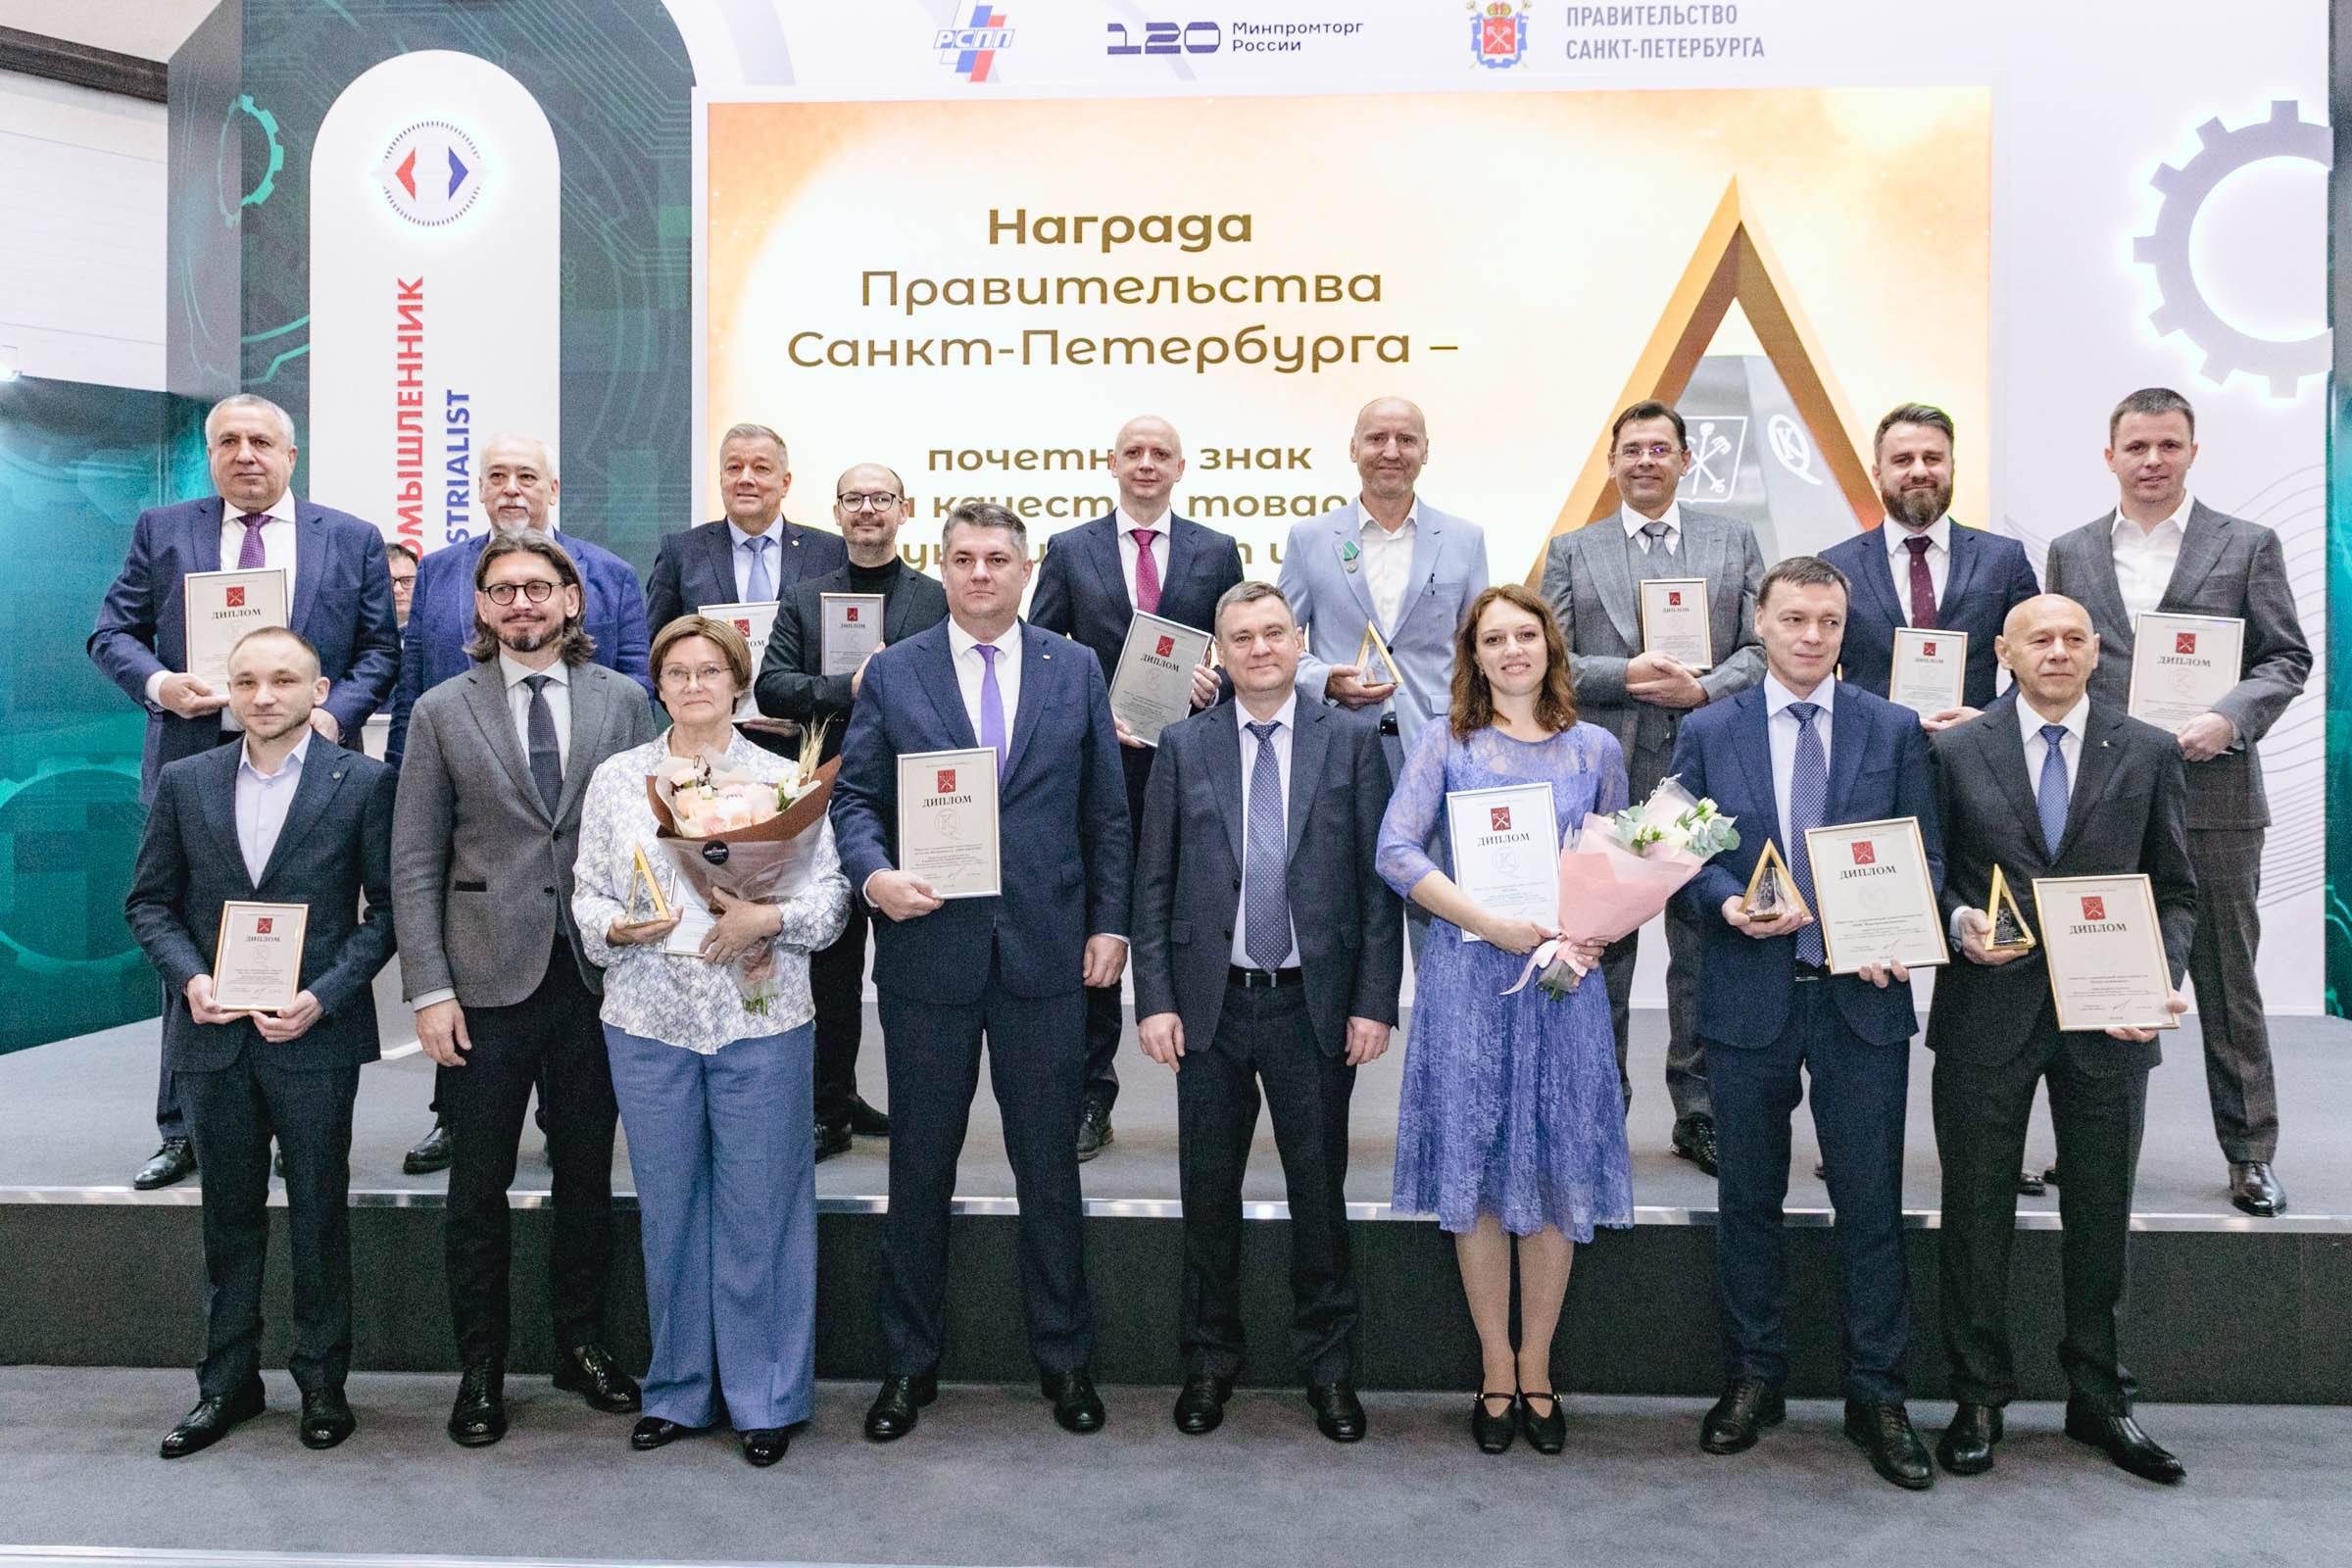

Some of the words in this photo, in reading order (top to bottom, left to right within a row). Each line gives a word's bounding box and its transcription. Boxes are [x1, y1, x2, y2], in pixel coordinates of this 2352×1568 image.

[1566, 4, 1738, 27] ПРАВИТЕЛЬСТВО
[933, 28, 1016, 49] РСПП
[1106, 22, 1221, 55] 120
[1232, 22, 1364, 37] Минпромторг
[1232, 39, 1301, 52] России
[1566, 36, 1766, 60] САНКТ-ПЕТЕРБУРГА
[989, 208, 1252, 253] Награда
[861, 270, 1383, 316] Правительства
[788, 323, 1411, 374] Санкт-Петербурга
[397, 276, 423, 562] МЫШЛЕННИК
[446, 389, 469, 544] STRIALIST
[929, 448, 1111, 471] почетн
[1199, 447, 1313, 470] знак
[1188, 495, 1348, 517] това
[212, 608, 262, 619] ДИПЛОМ
[1140, 653, 1180, 672] ДИПЛОМ
[2157, 656, 2211, 667] ДИПЛОМ
[922, 795, 972, 808] ДИПЛОМ
[1477, 832, 1531, 847] ДИПЛОМ
[1839, 864, 1897, 880] ДИПЛОМ
[2069, 923, 2128, 935] ДИПЛОМ
